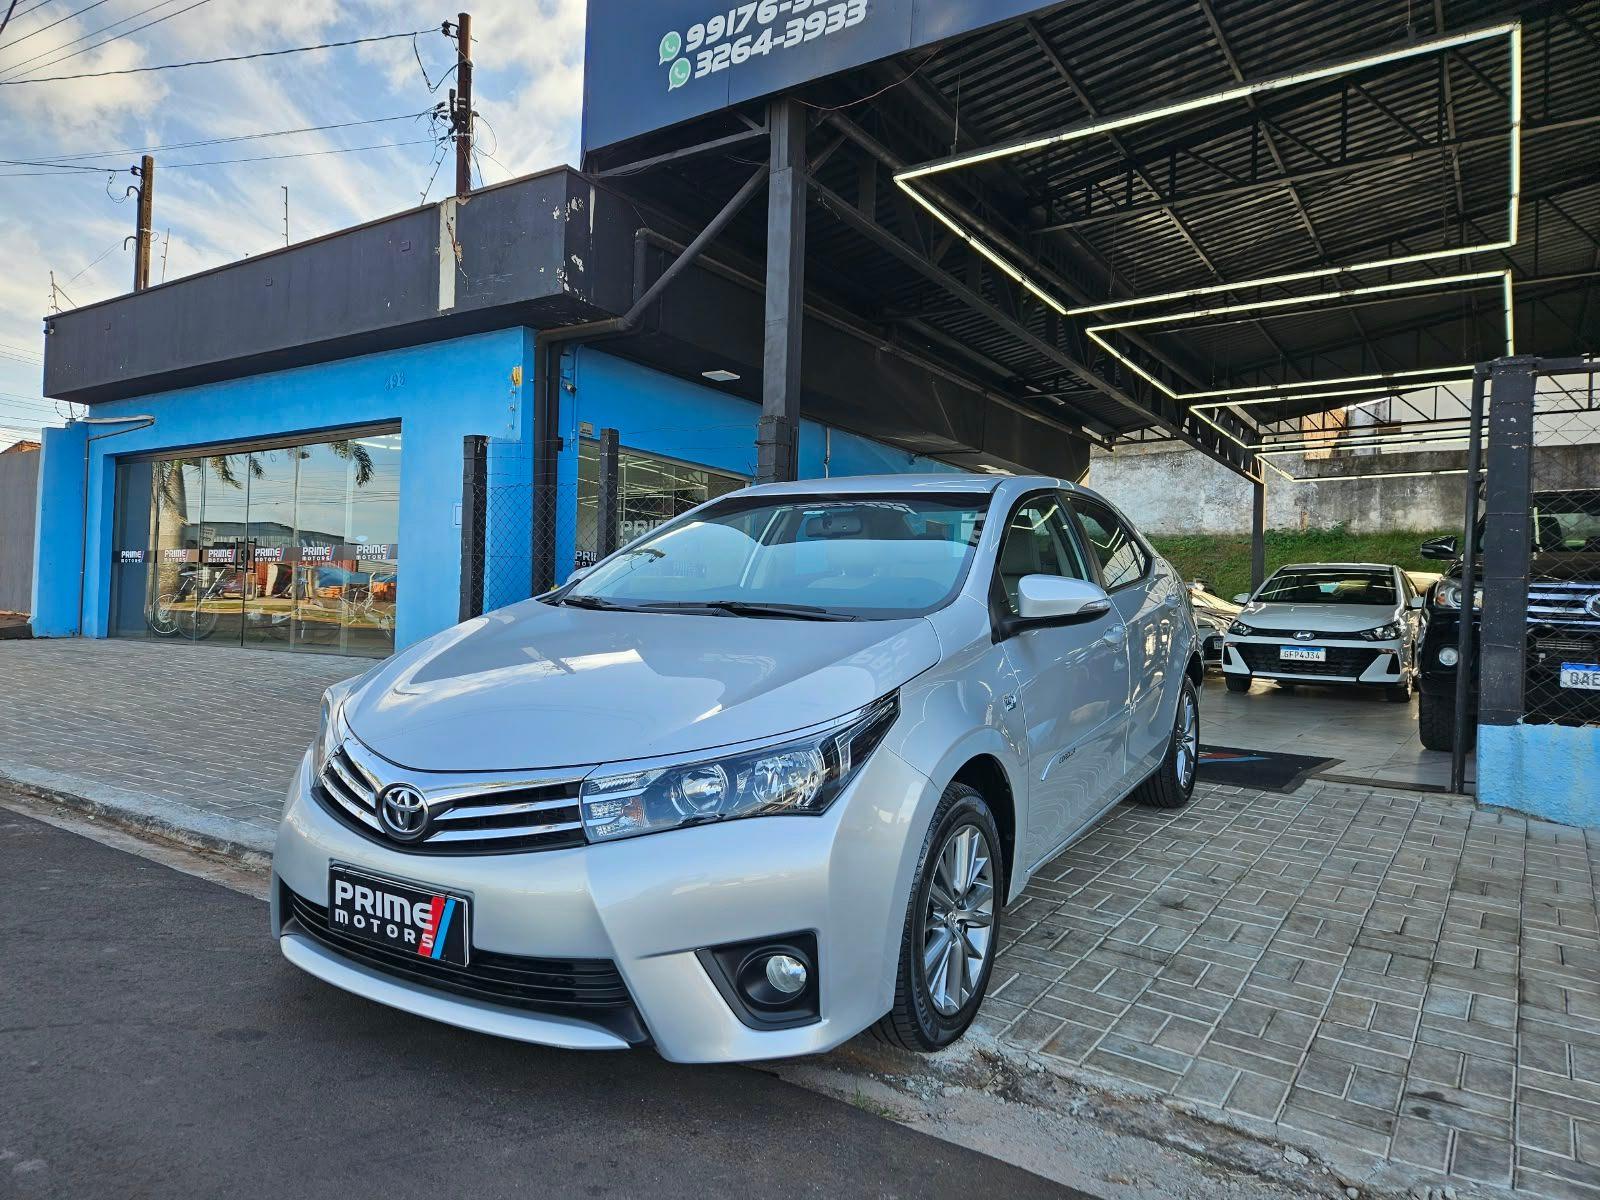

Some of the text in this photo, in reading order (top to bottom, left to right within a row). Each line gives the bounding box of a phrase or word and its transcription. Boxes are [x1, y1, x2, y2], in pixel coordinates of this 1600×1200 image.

[686, 0, 829, 53] 99176-
[694, 0, 868, 79] 3264-3933
[619, 519, 668, 536] PRI
[164, 549, 186, 557] PRIME
[208, 548, 232, 557] PRIME
[255, 547, 281, 557] PRIME
[302, 546, 331, 556] PRIME
[356, 544, 387, 554] PRIME
[1284, 650, 1320, 660] GFP4J34
[335, 879, 433, 931] PRIME
[335, 908, 433, 949] MOTORS
